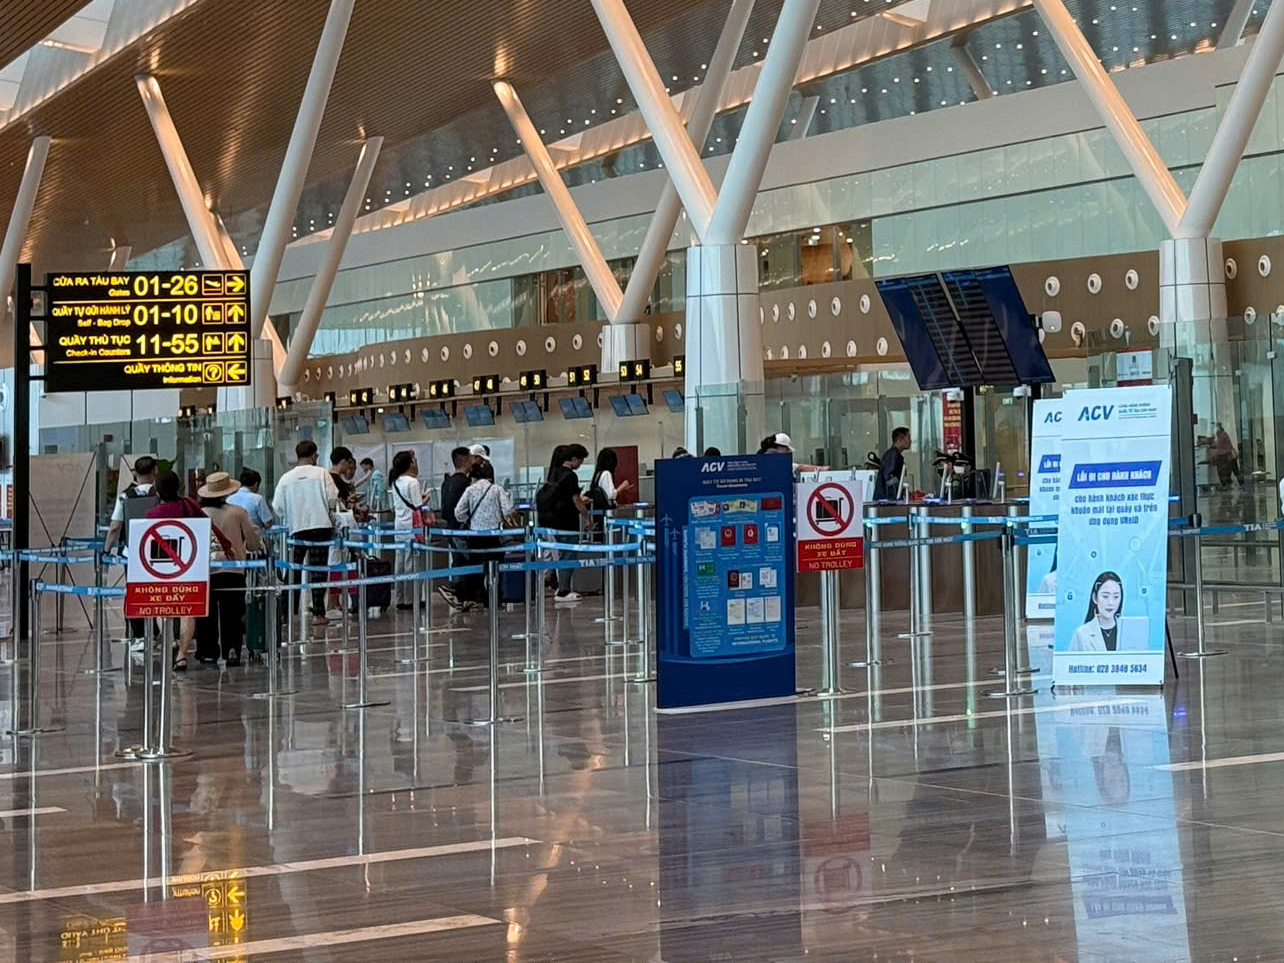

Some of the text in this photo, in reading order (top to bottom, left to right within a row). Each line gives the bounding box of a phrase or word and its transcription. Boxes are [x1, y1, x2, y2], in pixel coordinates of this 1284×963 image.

[75, 277, 88, 286] RA
[90, 276, 109, 285] TÀU
[111, 276, 130, 285] BAY
[134, 275, 198, 296] 01-26
[133, 304, 198, 325] 01-10
[97, 319, 112, 327] Bag
[113, 318, 131, 327] Drop
[59, 334, 87, 346] QUẦY
[110, 335, 131, 346] TỤC
[136, 333, 199, 354] 11-55
[124, 362, 201, 374] QUẦY THÔNG TIN
[1044, 412, 1062, 423] AC
[1077, 405, 1115, 421] ACV
[701, 461, 725, 473] ACV
[579, 559, 595, 567] TIA
[820, 560, 853, 568] TROLLEY
[135, 586, 168, 594] KHÔNG
[139, 606, 192, 615] NO TROLLEY
[1068, 664, 1095, 674] Hotline:
[1096, 664, 1109, 673] 028
[1130, 663, 1147, 673] 5634
